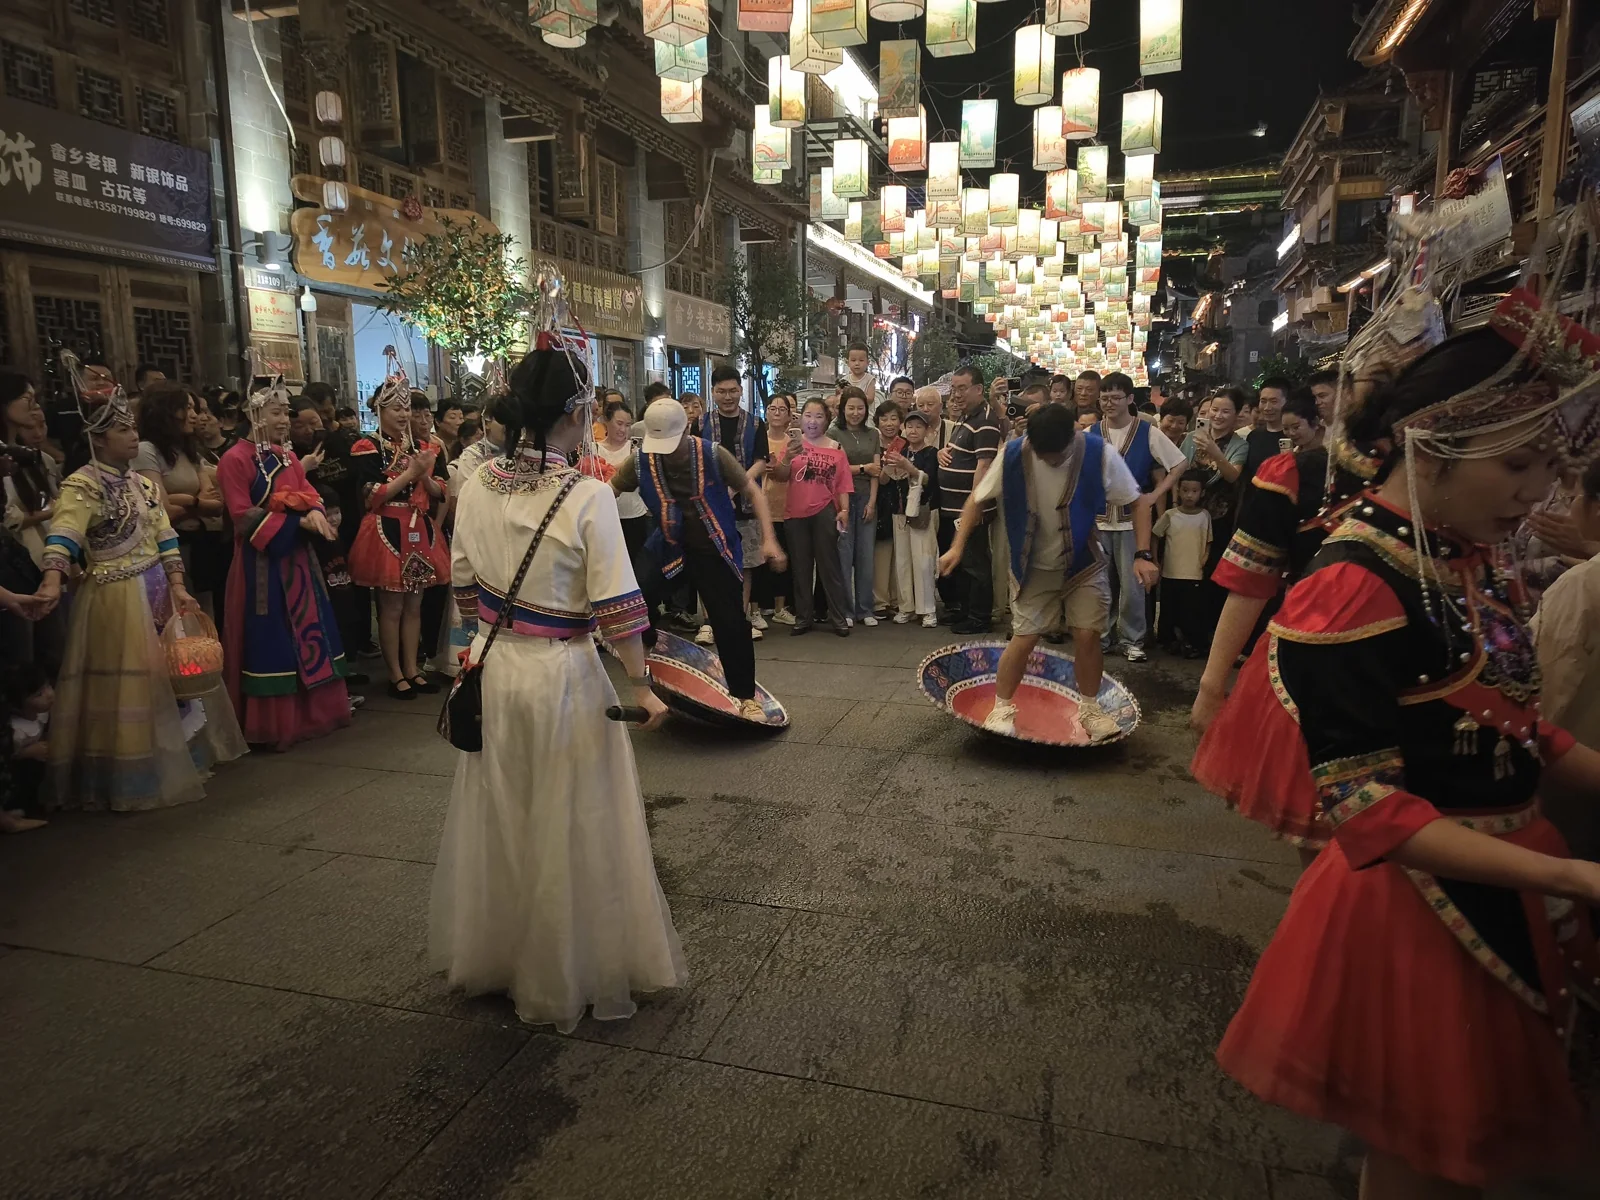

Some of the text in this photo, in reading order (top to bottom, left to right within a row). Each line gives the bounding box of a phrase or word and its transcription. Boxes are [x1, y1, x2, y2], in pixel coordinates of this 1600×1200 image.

[53, 168, 147, 205] 器皿 古玩等
[130, 163, 189, 193] 新银饰品
